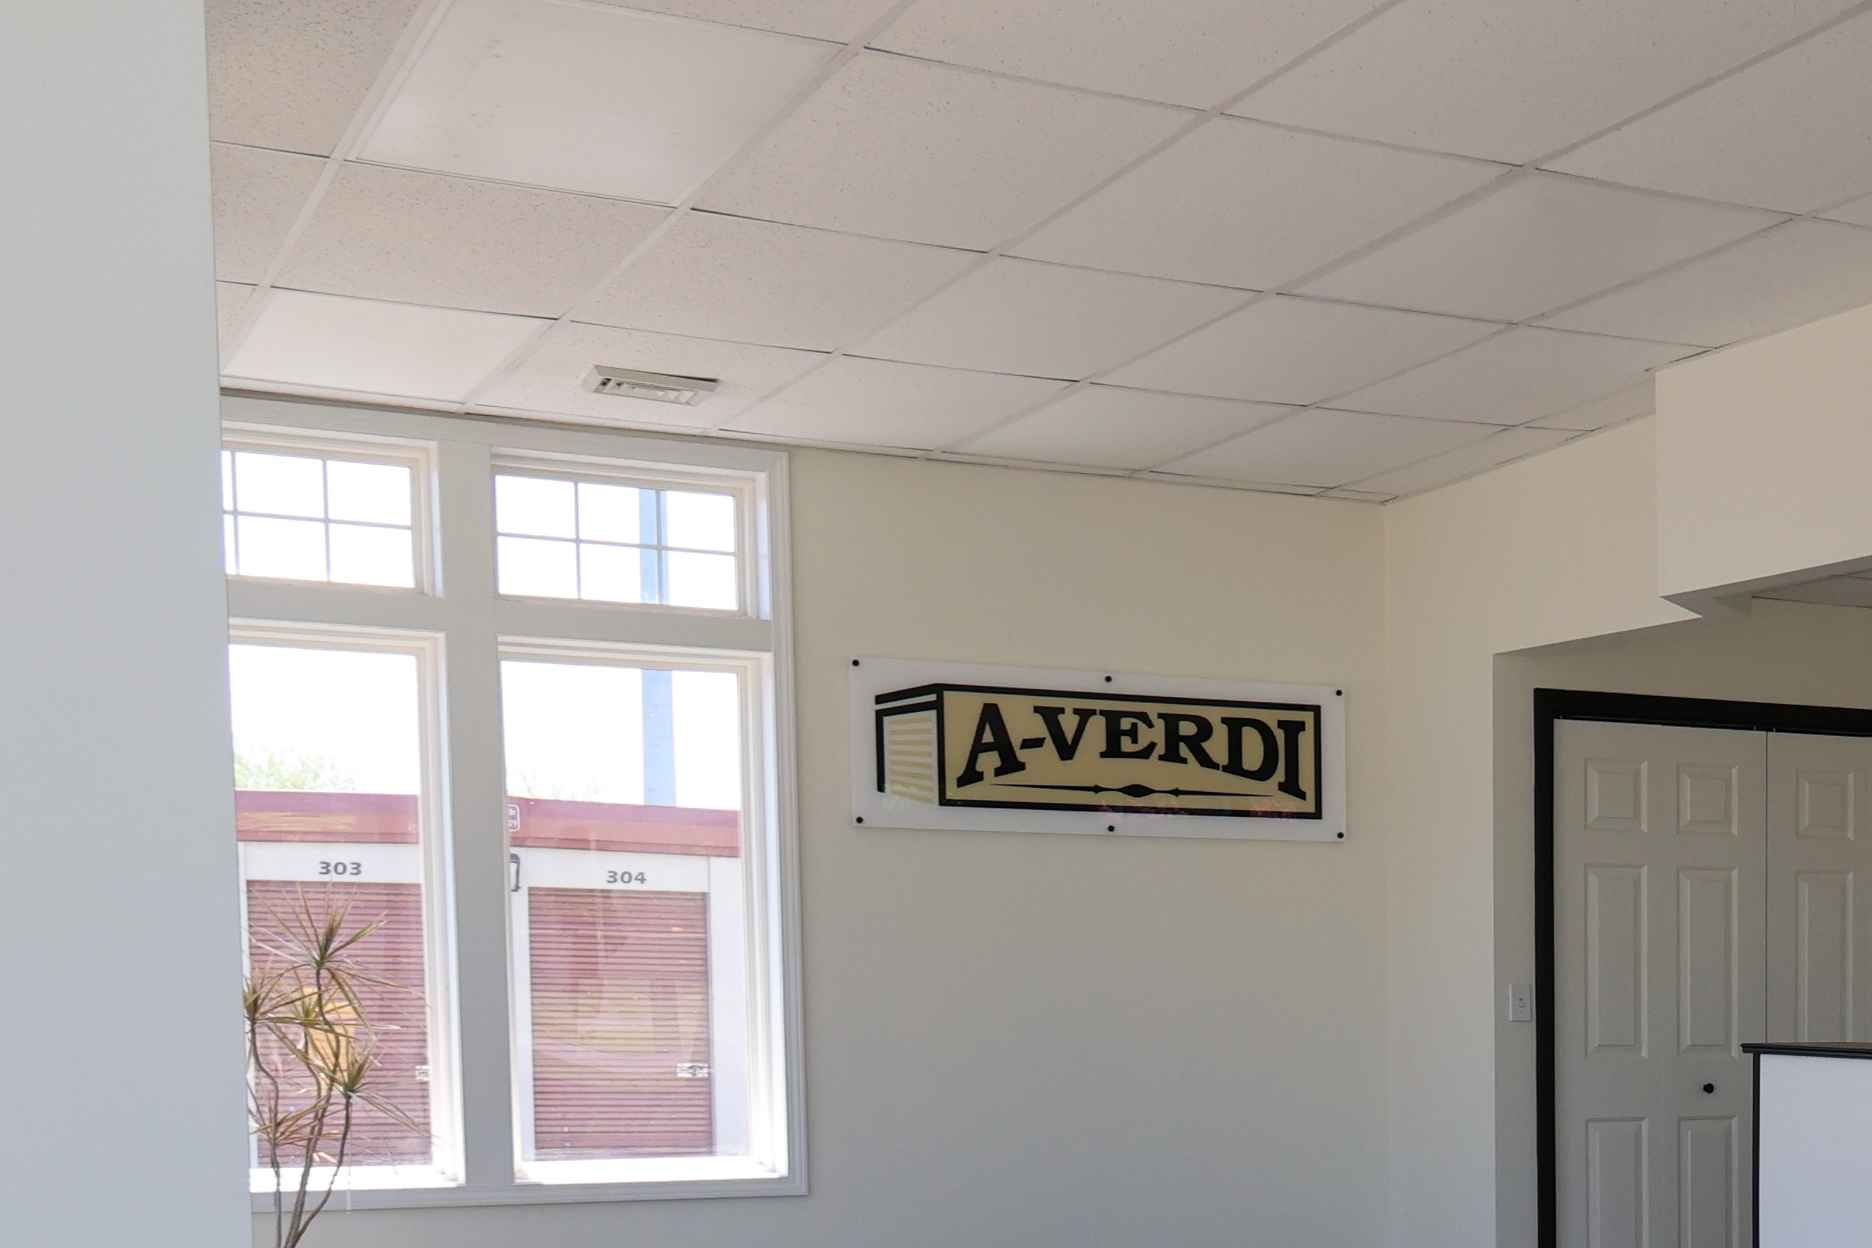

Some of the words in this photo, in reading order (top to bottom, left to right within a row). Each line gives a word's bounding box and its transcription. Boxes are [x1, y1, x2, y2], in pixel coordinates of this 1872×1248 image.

[956, 702, 1307, 801] A-VERDI
[318, 861, 362, 876] 303
[606, 870, 647, 884] 304
